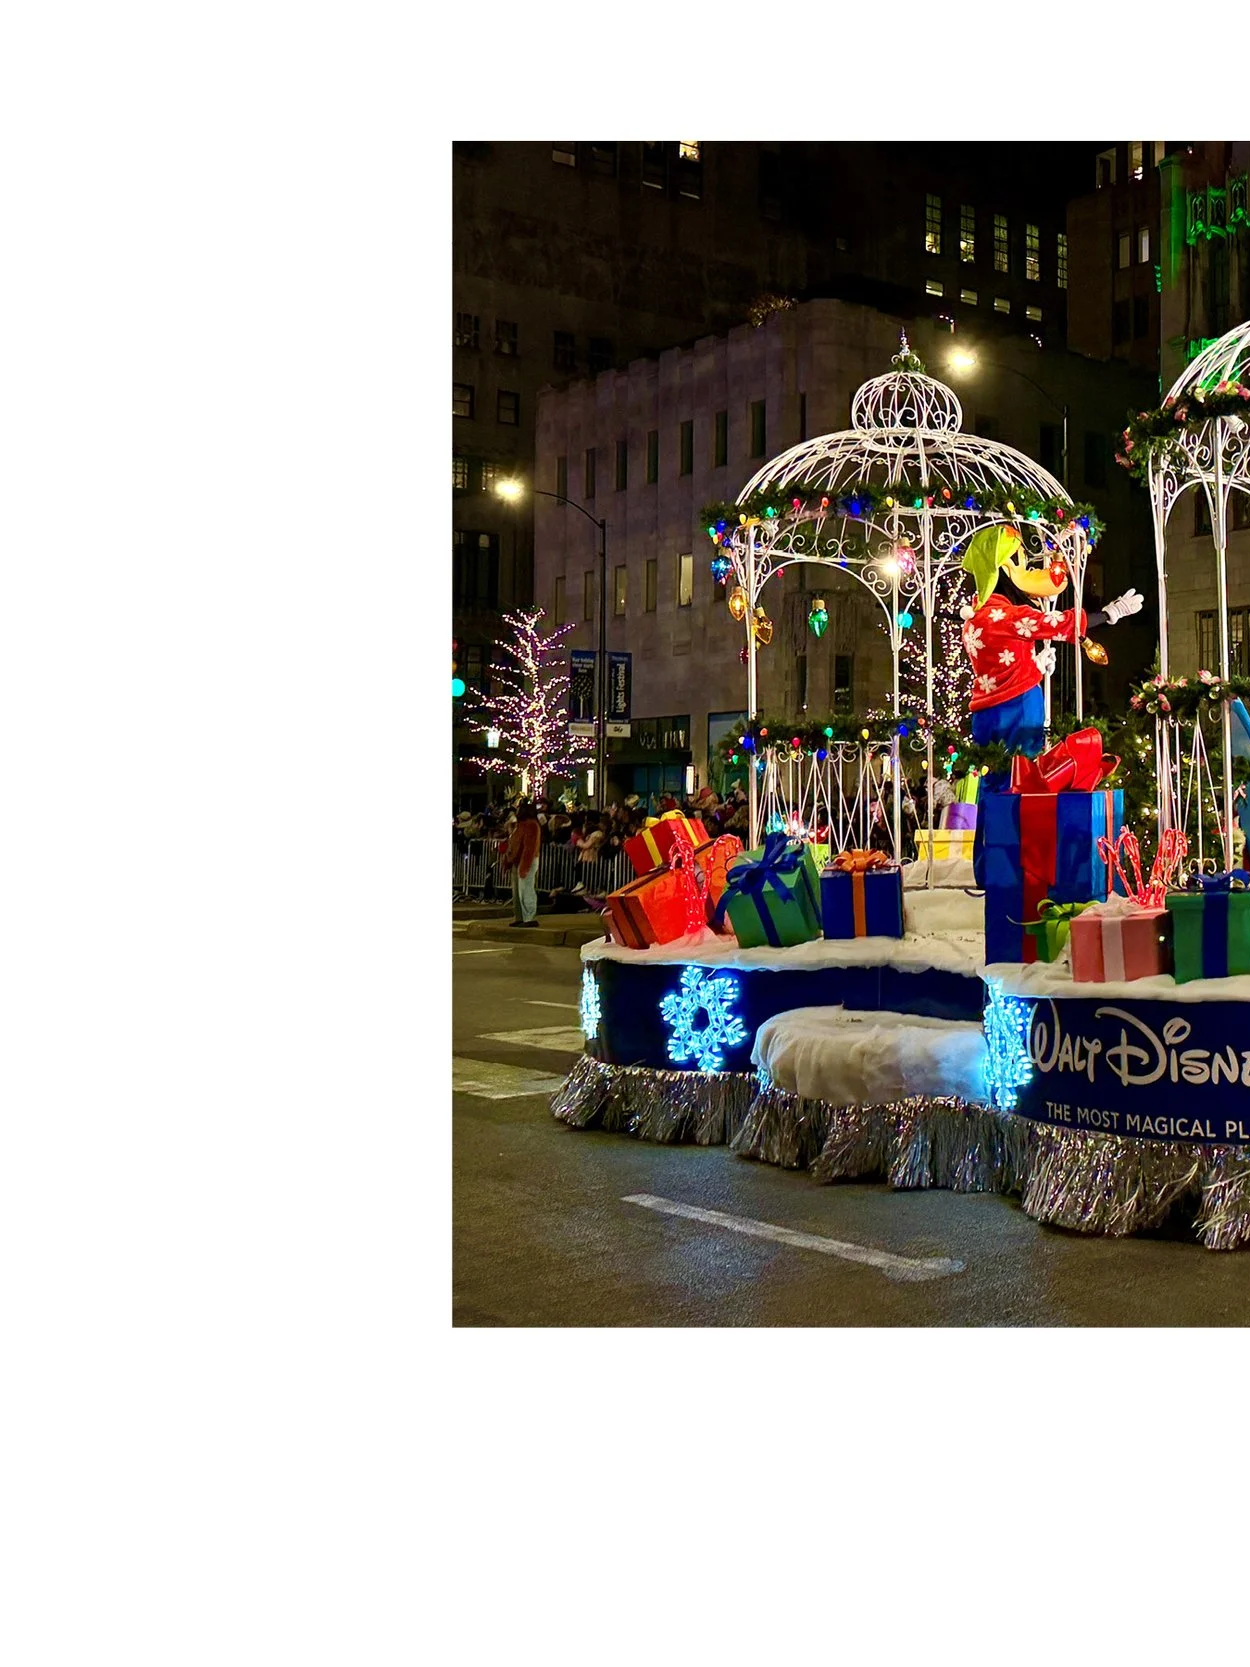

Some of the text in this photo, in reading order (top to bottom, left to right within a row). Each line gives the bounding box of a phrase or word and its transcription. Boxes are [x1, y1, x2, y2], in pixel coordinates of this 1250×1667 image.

[1026, 997, 1102, 1083] WALT
[1046, 1101, 1072, 1122] THE
[1077, 1106, 1120, 1129] MOST
[1126, 1113, 1217, 1139] MAGICAL
